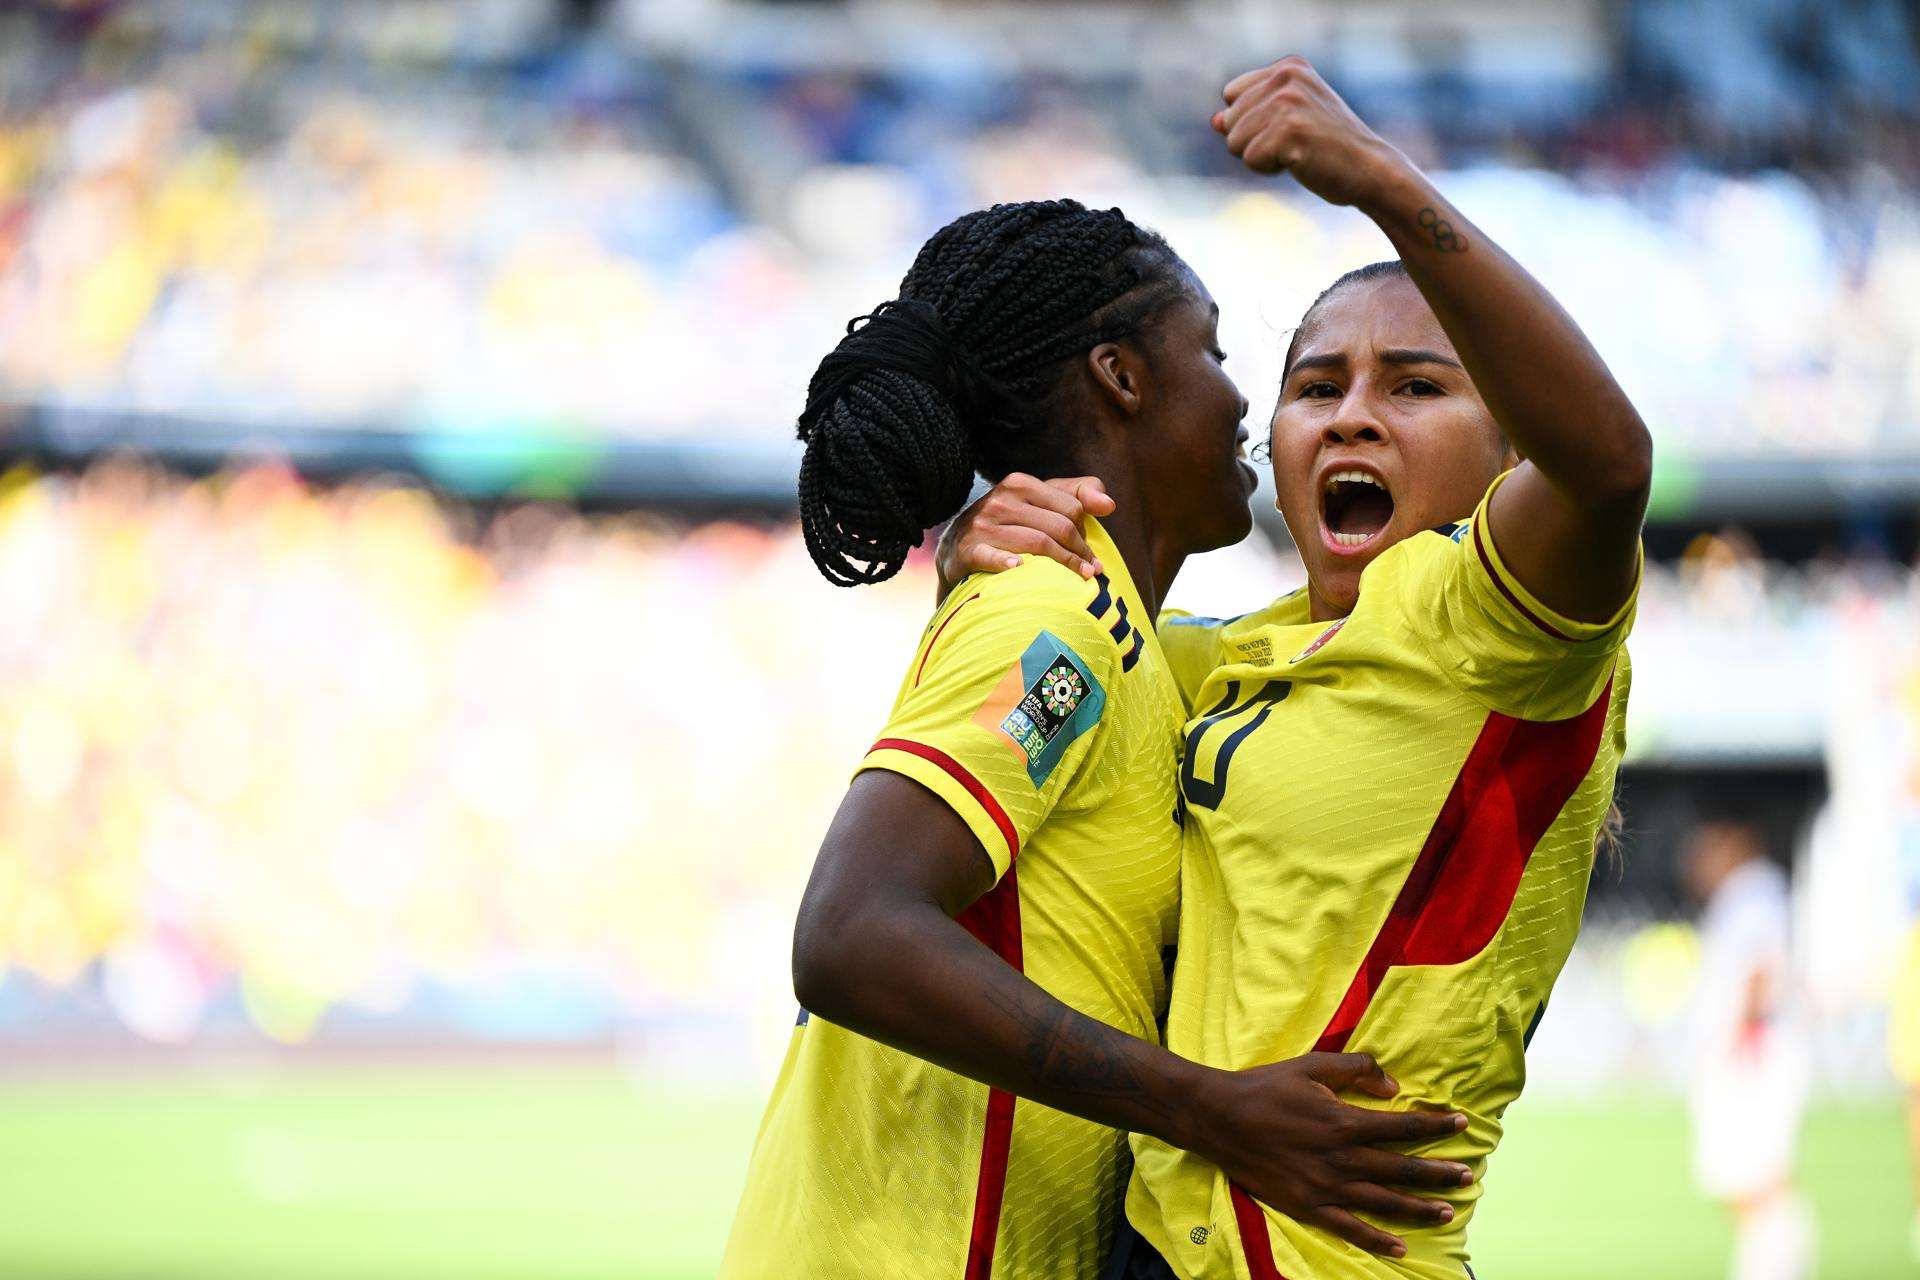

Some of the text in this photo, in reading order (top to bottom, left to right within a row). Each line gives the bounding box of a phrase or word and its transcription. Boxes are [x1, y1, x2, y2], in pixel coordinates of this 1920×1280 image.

[1028, 693, 1042, 709] FIFA
[1021, 703, 1048, 733] WORLD CUP
